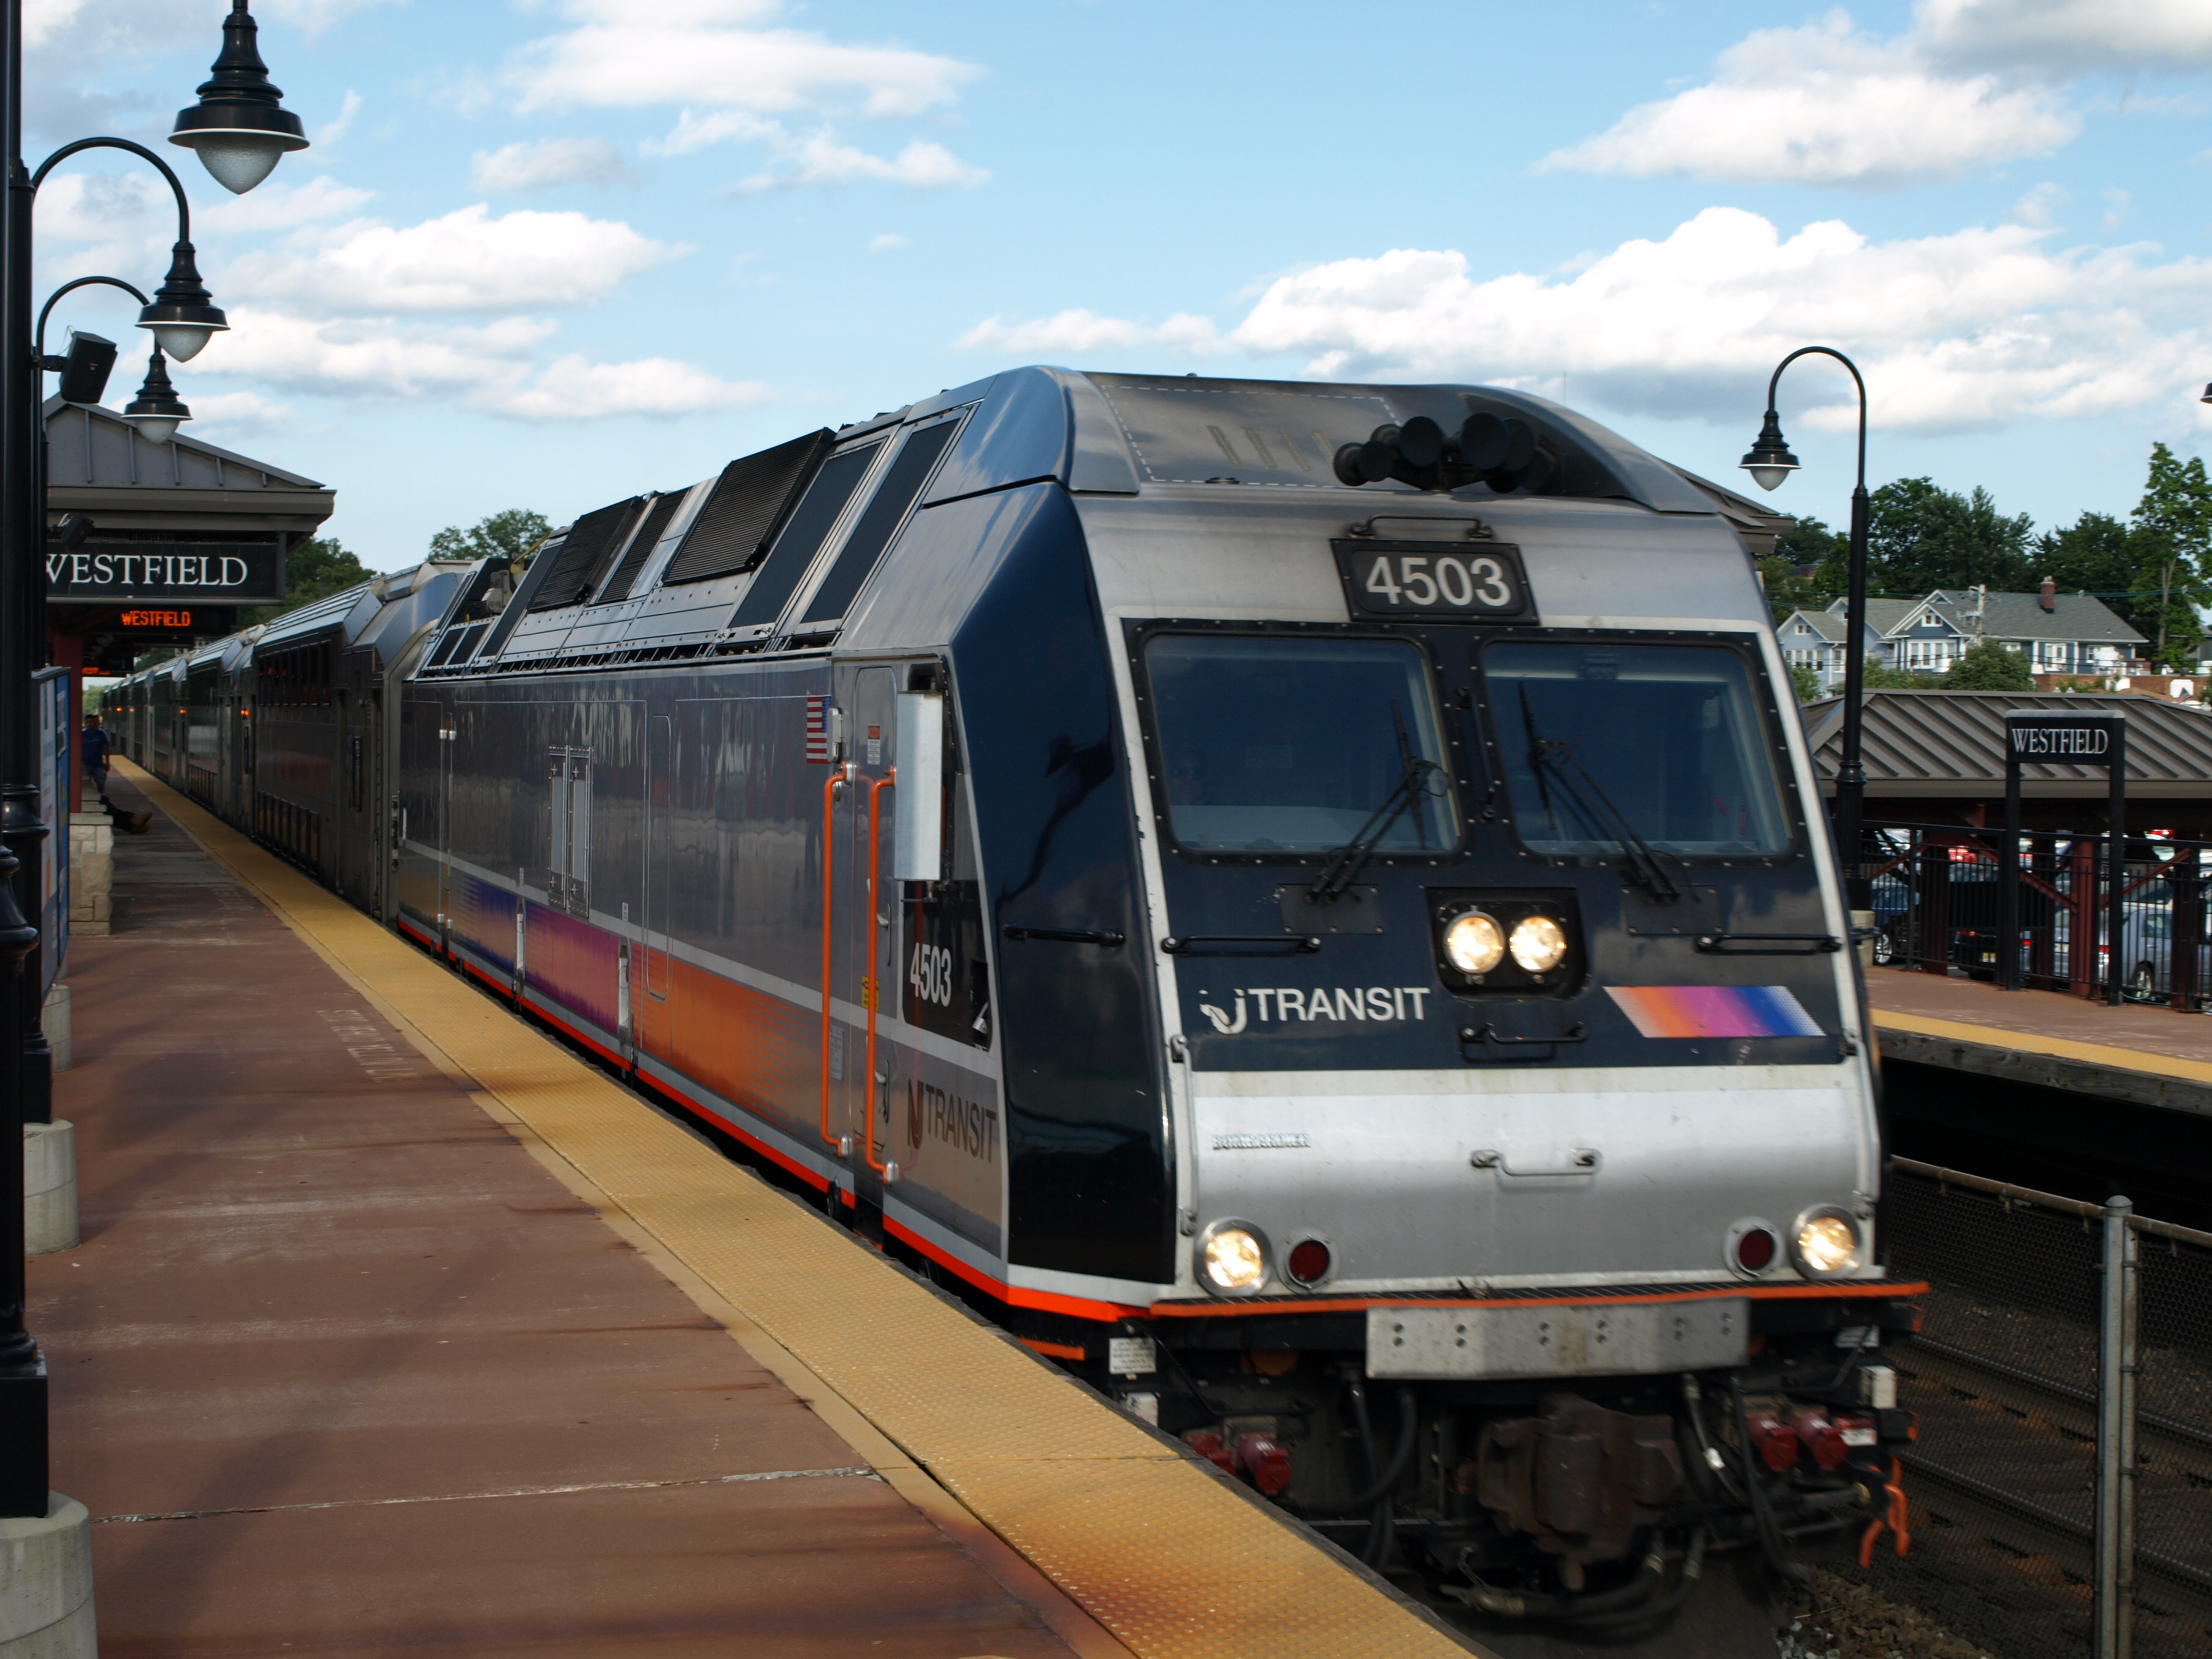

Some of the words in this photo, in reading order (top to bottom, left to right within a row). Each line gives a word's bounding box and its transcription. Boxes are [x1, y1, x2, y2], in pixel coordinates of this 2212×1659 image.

[1366, 556, 1511, 606] 4503
[121, 611, 191, 626] WESTFIELD
[2011, 728, 2108, 754] WESTFIELD
[910, 942, 951, 1007] 4503
[1247, 987, 1430, 1021] TRANSIT
[907, 1078, 924, 1150] NJ
[925, 1083, 996, 1164] TRANSIT
